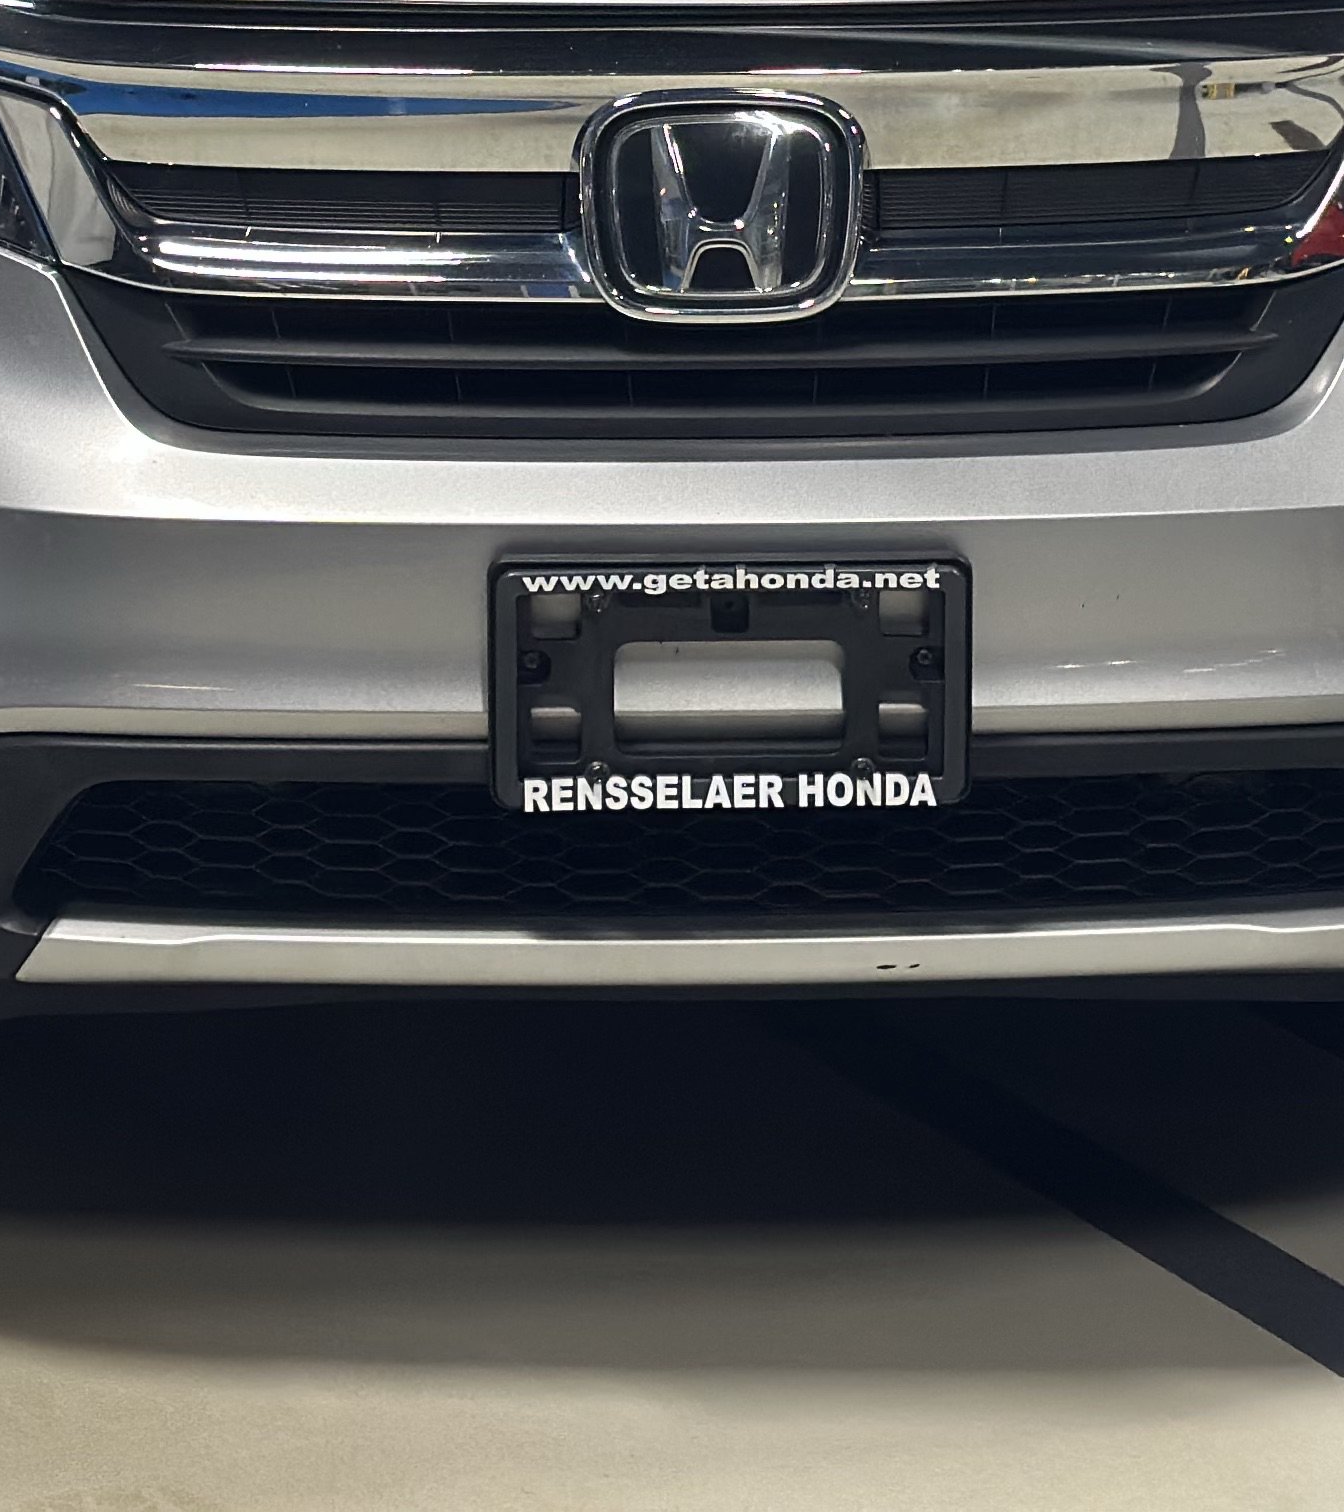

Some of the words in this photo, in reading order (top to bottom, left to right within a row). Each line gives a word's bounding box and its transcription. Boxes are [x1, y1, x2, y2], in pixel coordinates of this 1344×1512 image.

[651, 123, 791, 293] H
[523, 568, 940, 595] www.getahonda.net
[524, 774, 784, 812] RENSSELAER
[798, 772, 937, 807] HONDA
